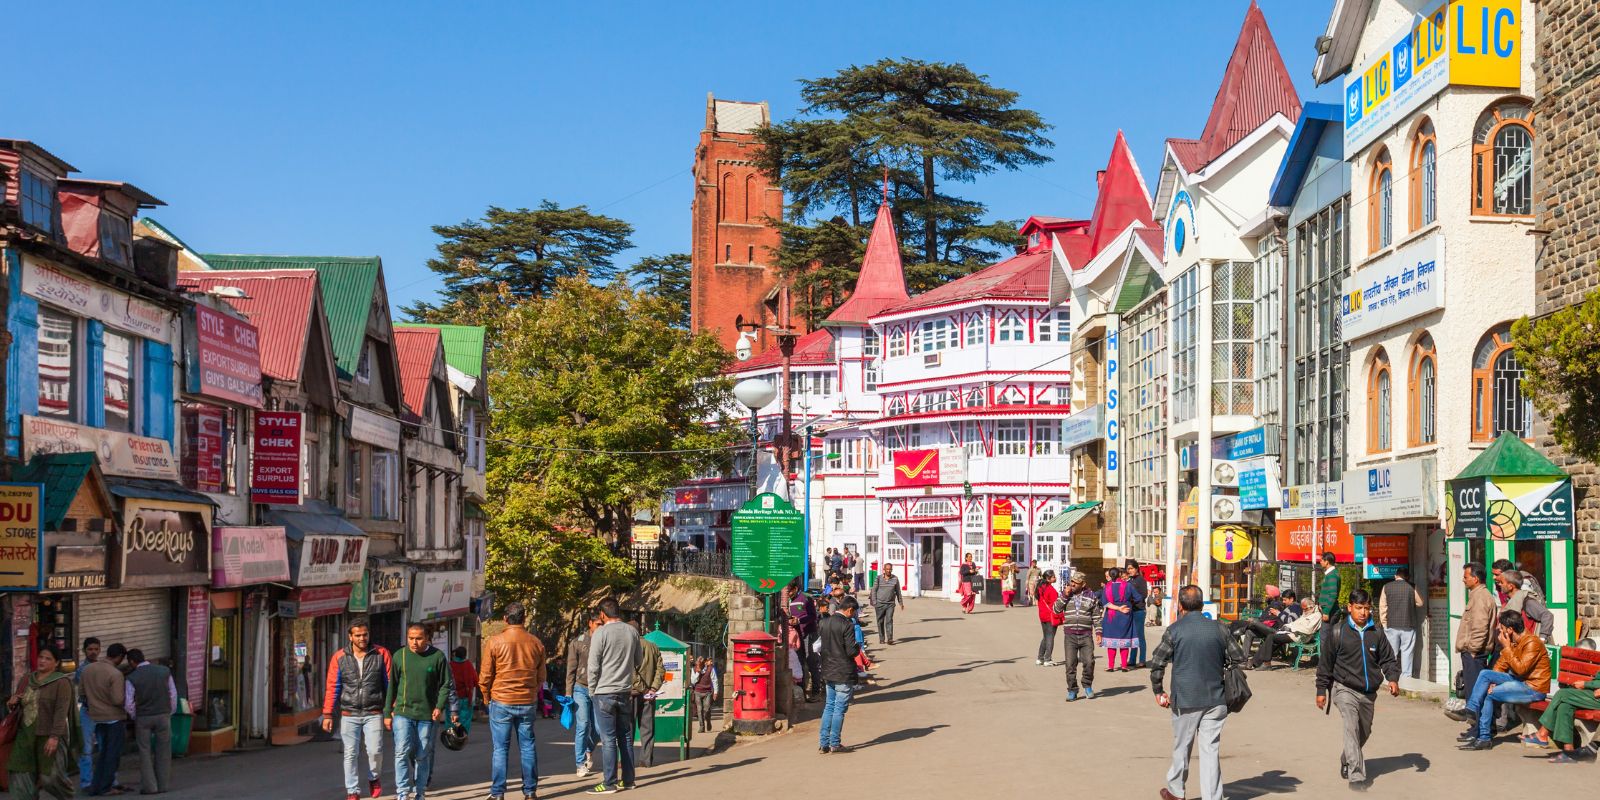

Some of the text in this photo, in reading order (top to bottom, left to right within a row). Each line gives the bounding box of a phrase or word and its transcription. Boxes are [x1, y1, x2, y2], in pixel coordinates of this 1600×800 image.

[1416, 11, 1444, 67] LIC
[1457, 5, 1514, 58] LIC
[1366, 59, 1387, 107] LIC
[1364, 260, 1435, 300] भारतीय जीवन बीमा निगम
[1350, 292, 1360, 312] LIC
[201, 312, 224, 337] STYLE
[234, 324, 258, 350] CHEK
[206, 370, 224, 388] GUYS
[228, 377, 244, 394] GALS
[259, 417, 296, 426] STYLE
[128, 438, 164, 454] Oriental
[260, 438, 294, 447] CHEK
[132, 454, 169, 468] insurance
[1379, 469, 1390, 488] LIC
[1460, 488, 1480, 509] CCC
[1531, 498, 1566, 516] CC
[6, 528, 36, 538] STORE
[126, 516, 194, 564] Beekays
[1326, 524, 1337, 546] बैंक
[240, 536, 265, 554] Kodak
[49, 575, 106, 588] GURU PAN PALACE
